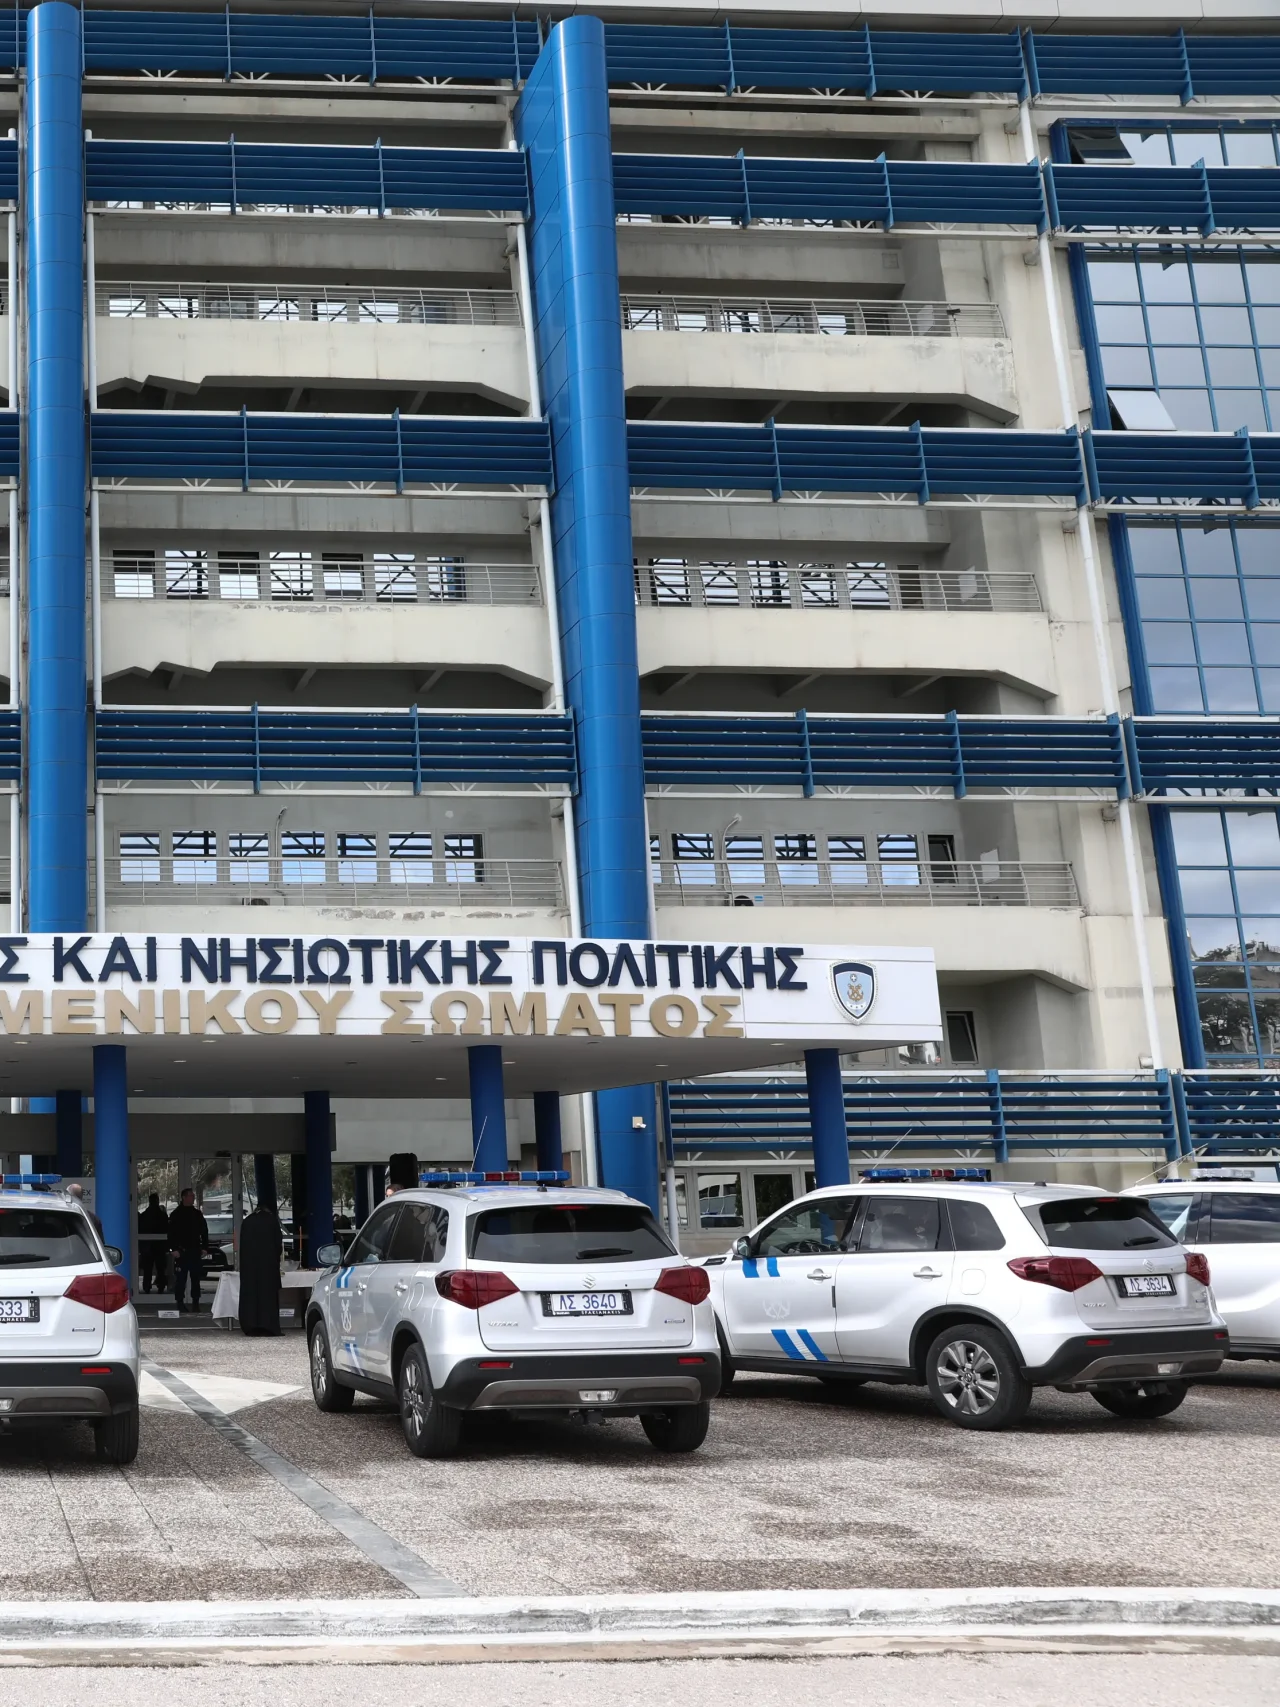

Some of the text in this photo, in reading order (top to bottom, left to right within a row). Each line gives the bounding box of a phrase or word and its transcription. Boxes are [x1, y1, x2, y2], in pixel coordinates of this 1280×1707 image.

[53, 936, 158, 983] ΚΑΙ
[180, 937, 513, 986] ΝΗΣΙΩΤΙΚΗΣ
[531, 940, 808, 991] ΠΟΛΙΤΙΚΗΣ
[380, 991, 745, 1039] ΣΩΜΑΤΟΣ
[1130, 1277, 1167, 1291] ΛΣ 3634
[560, 1294, 617, 1310] ΛΣ 3640
